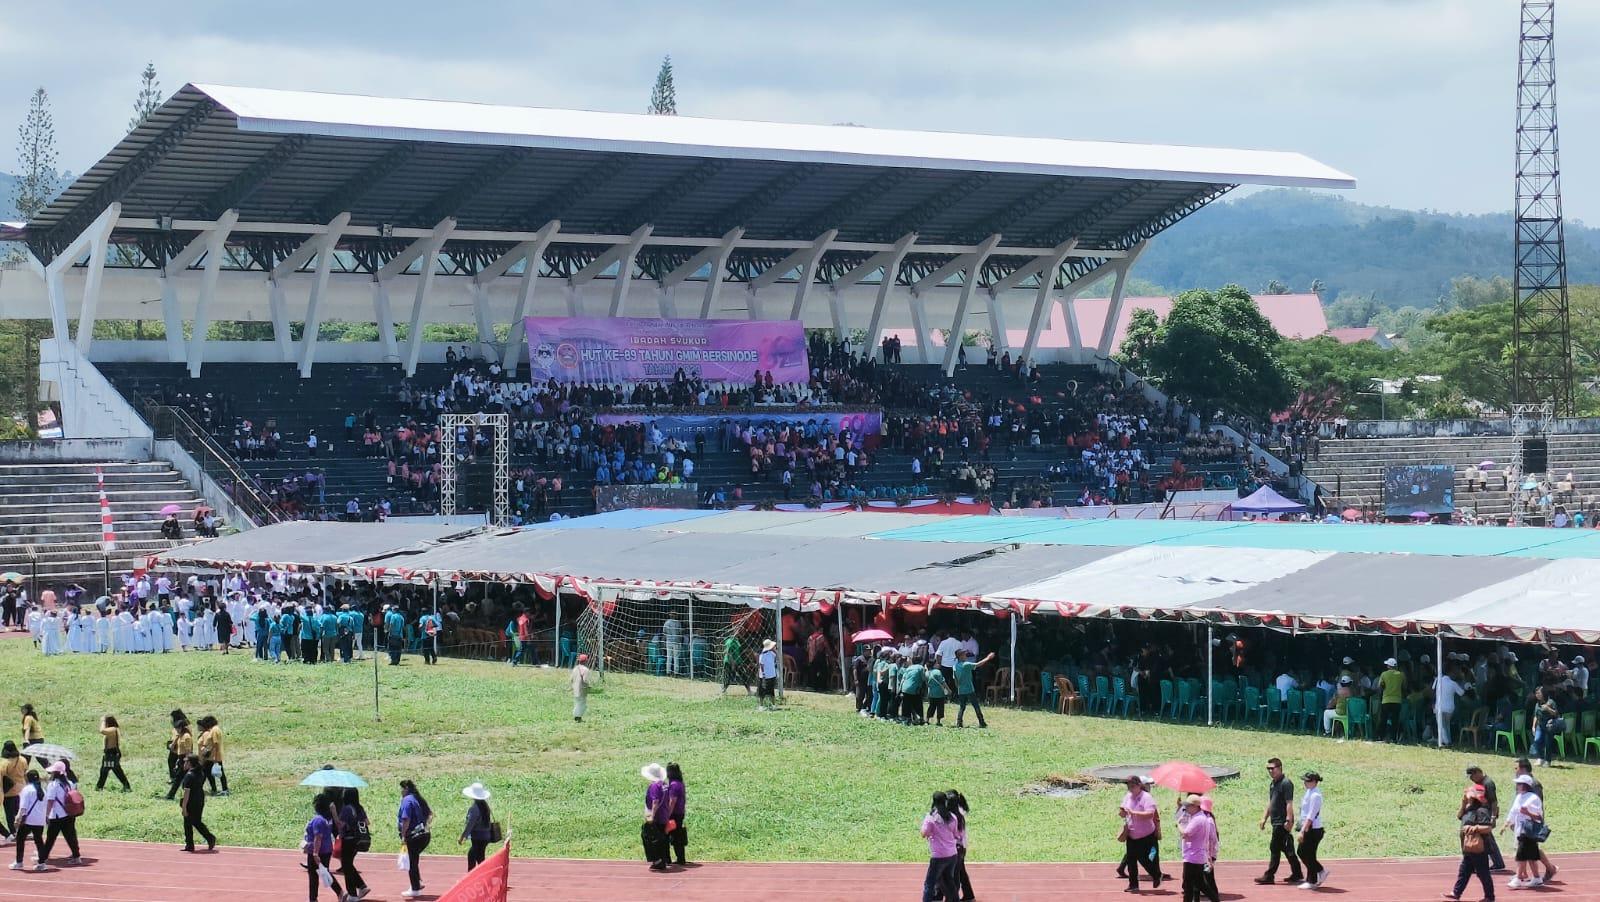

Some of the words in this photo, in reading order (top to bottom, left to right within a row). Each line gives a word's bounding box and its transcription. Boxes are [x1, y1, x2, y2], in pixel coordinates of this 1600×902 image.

[630, 336, 667, 346] IBADAH
[670, 337, 708, 347] SYUKUR
[580, 349, 602, 361] HUT
[604, 349, 637, 361] KE-89
[639, 349, 673, 361] TAHUN
[676, 350, 700, 361] GMIM
[702, 350, 758, 361] BERSINODE
